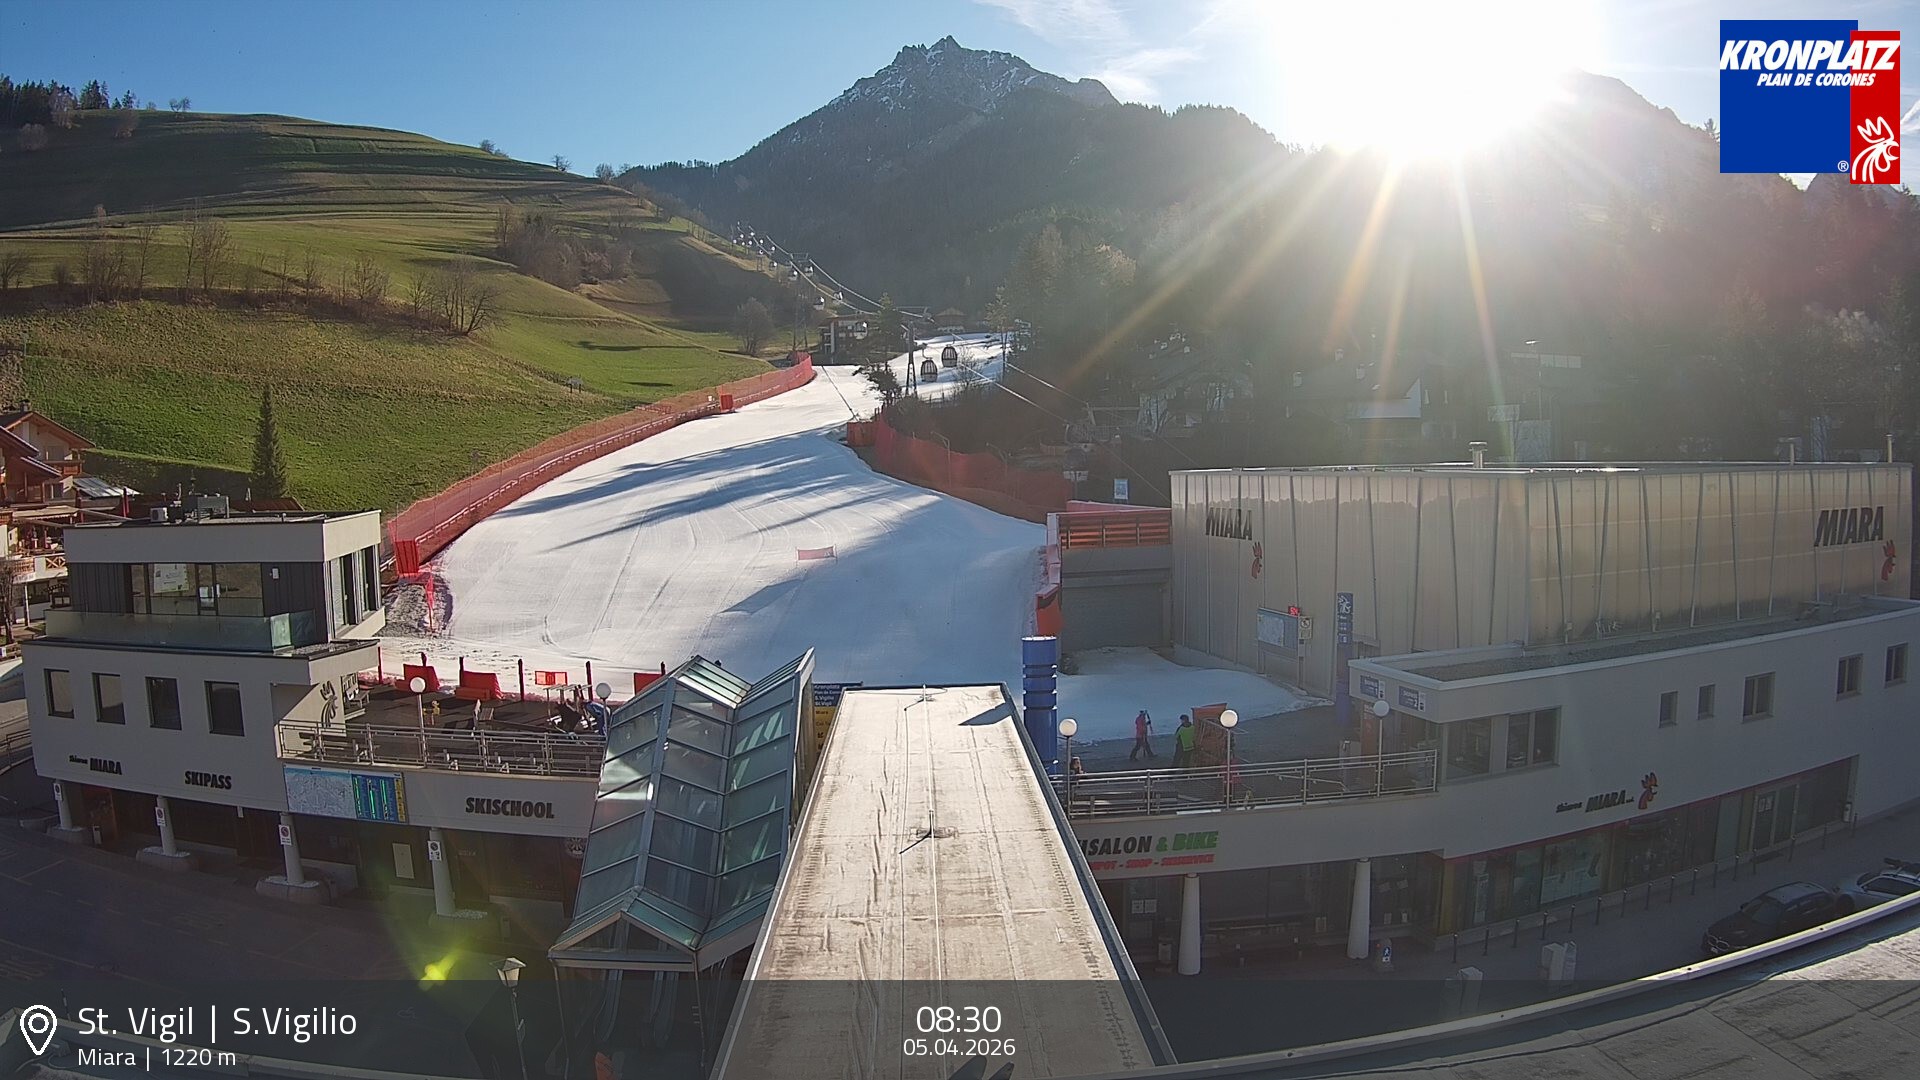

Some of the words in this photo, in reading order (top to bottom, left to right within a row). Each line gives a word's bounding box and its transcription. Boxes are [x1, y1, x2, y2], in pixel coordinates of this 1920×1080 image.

[1206, 507, 1252, 540] MIARA
[1814, 506, 1884, 547] MIARA
[89, 757, 122, 775] MIARA
[185, 770, 232, 790] SKIPASS
[465, 797, 555, 819] SKISCHOOL
[1585, 790, 1626, 813] MIARA
[1079, 835, 1153, 856] ISALON
[1156, 837, 1168, 853] &
[1172, 831, 1219, 850] BIKE
